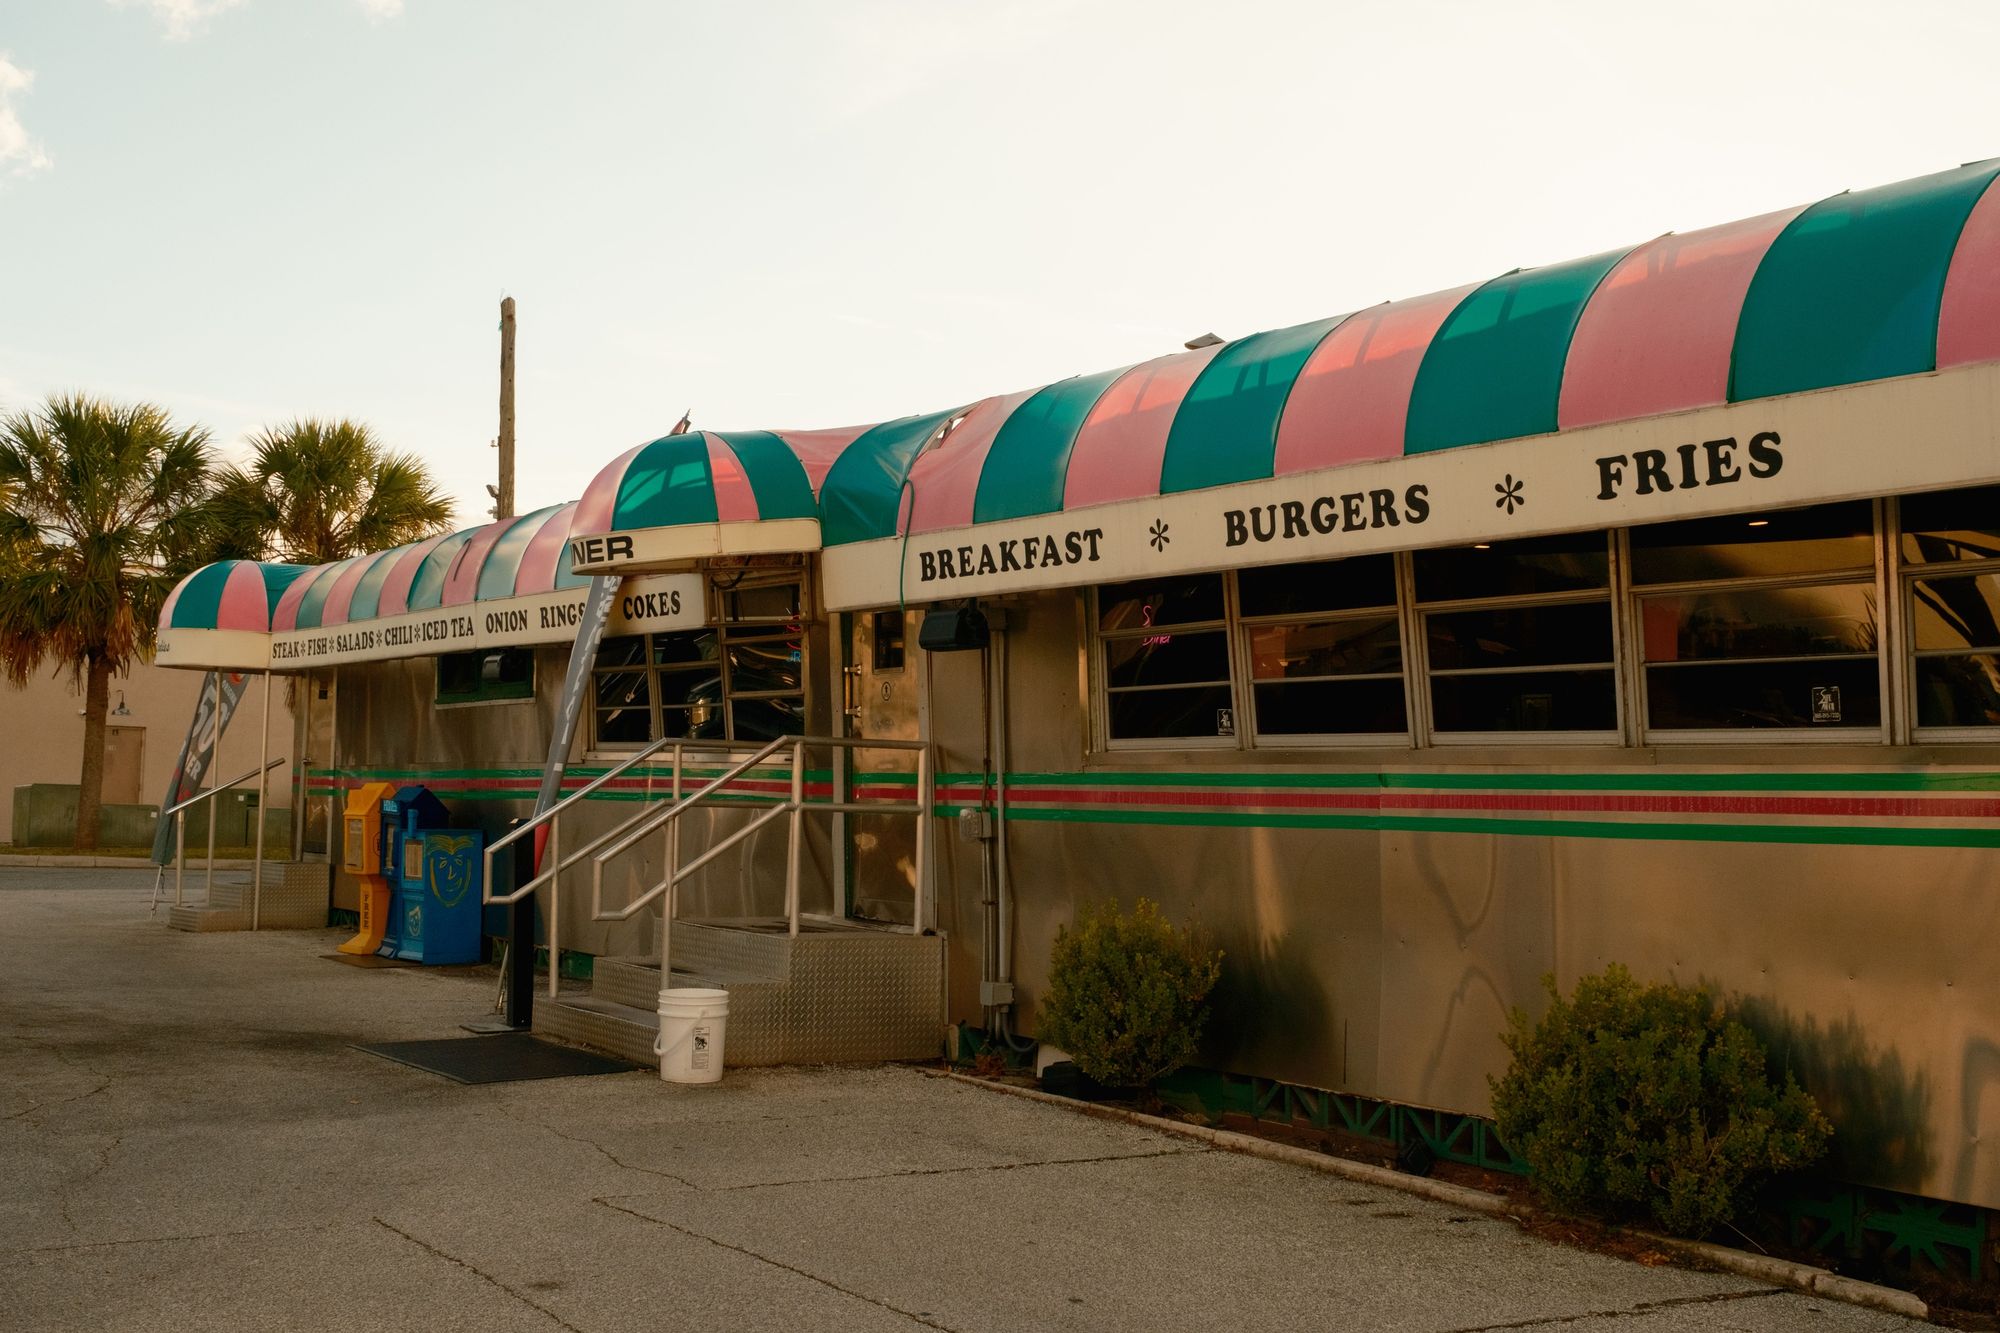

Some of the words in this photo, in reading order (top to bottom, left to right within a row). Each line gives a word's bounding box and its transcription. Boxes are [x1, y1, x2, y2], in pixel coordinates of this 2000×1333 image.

[919, 527, 1103, 582] BREAKFAST
[1223, 484, 1431, 547] BURGERS
[1595, 431, 1784, 501] FRIES
[272, 641, 300, 659] STEAK
[307, 637, 328, 656] FISH
[336, 630, 375, 653] SALADS
[384, 624, 413, 647] CHILI
[422, 619, 448, 642] ICED
[450, 615, 475, 638] TEA
[485, 609, 528, 634] ONION
[539, 602, 586, 629] RINGS
[622, 590, 681, 621] COKES
